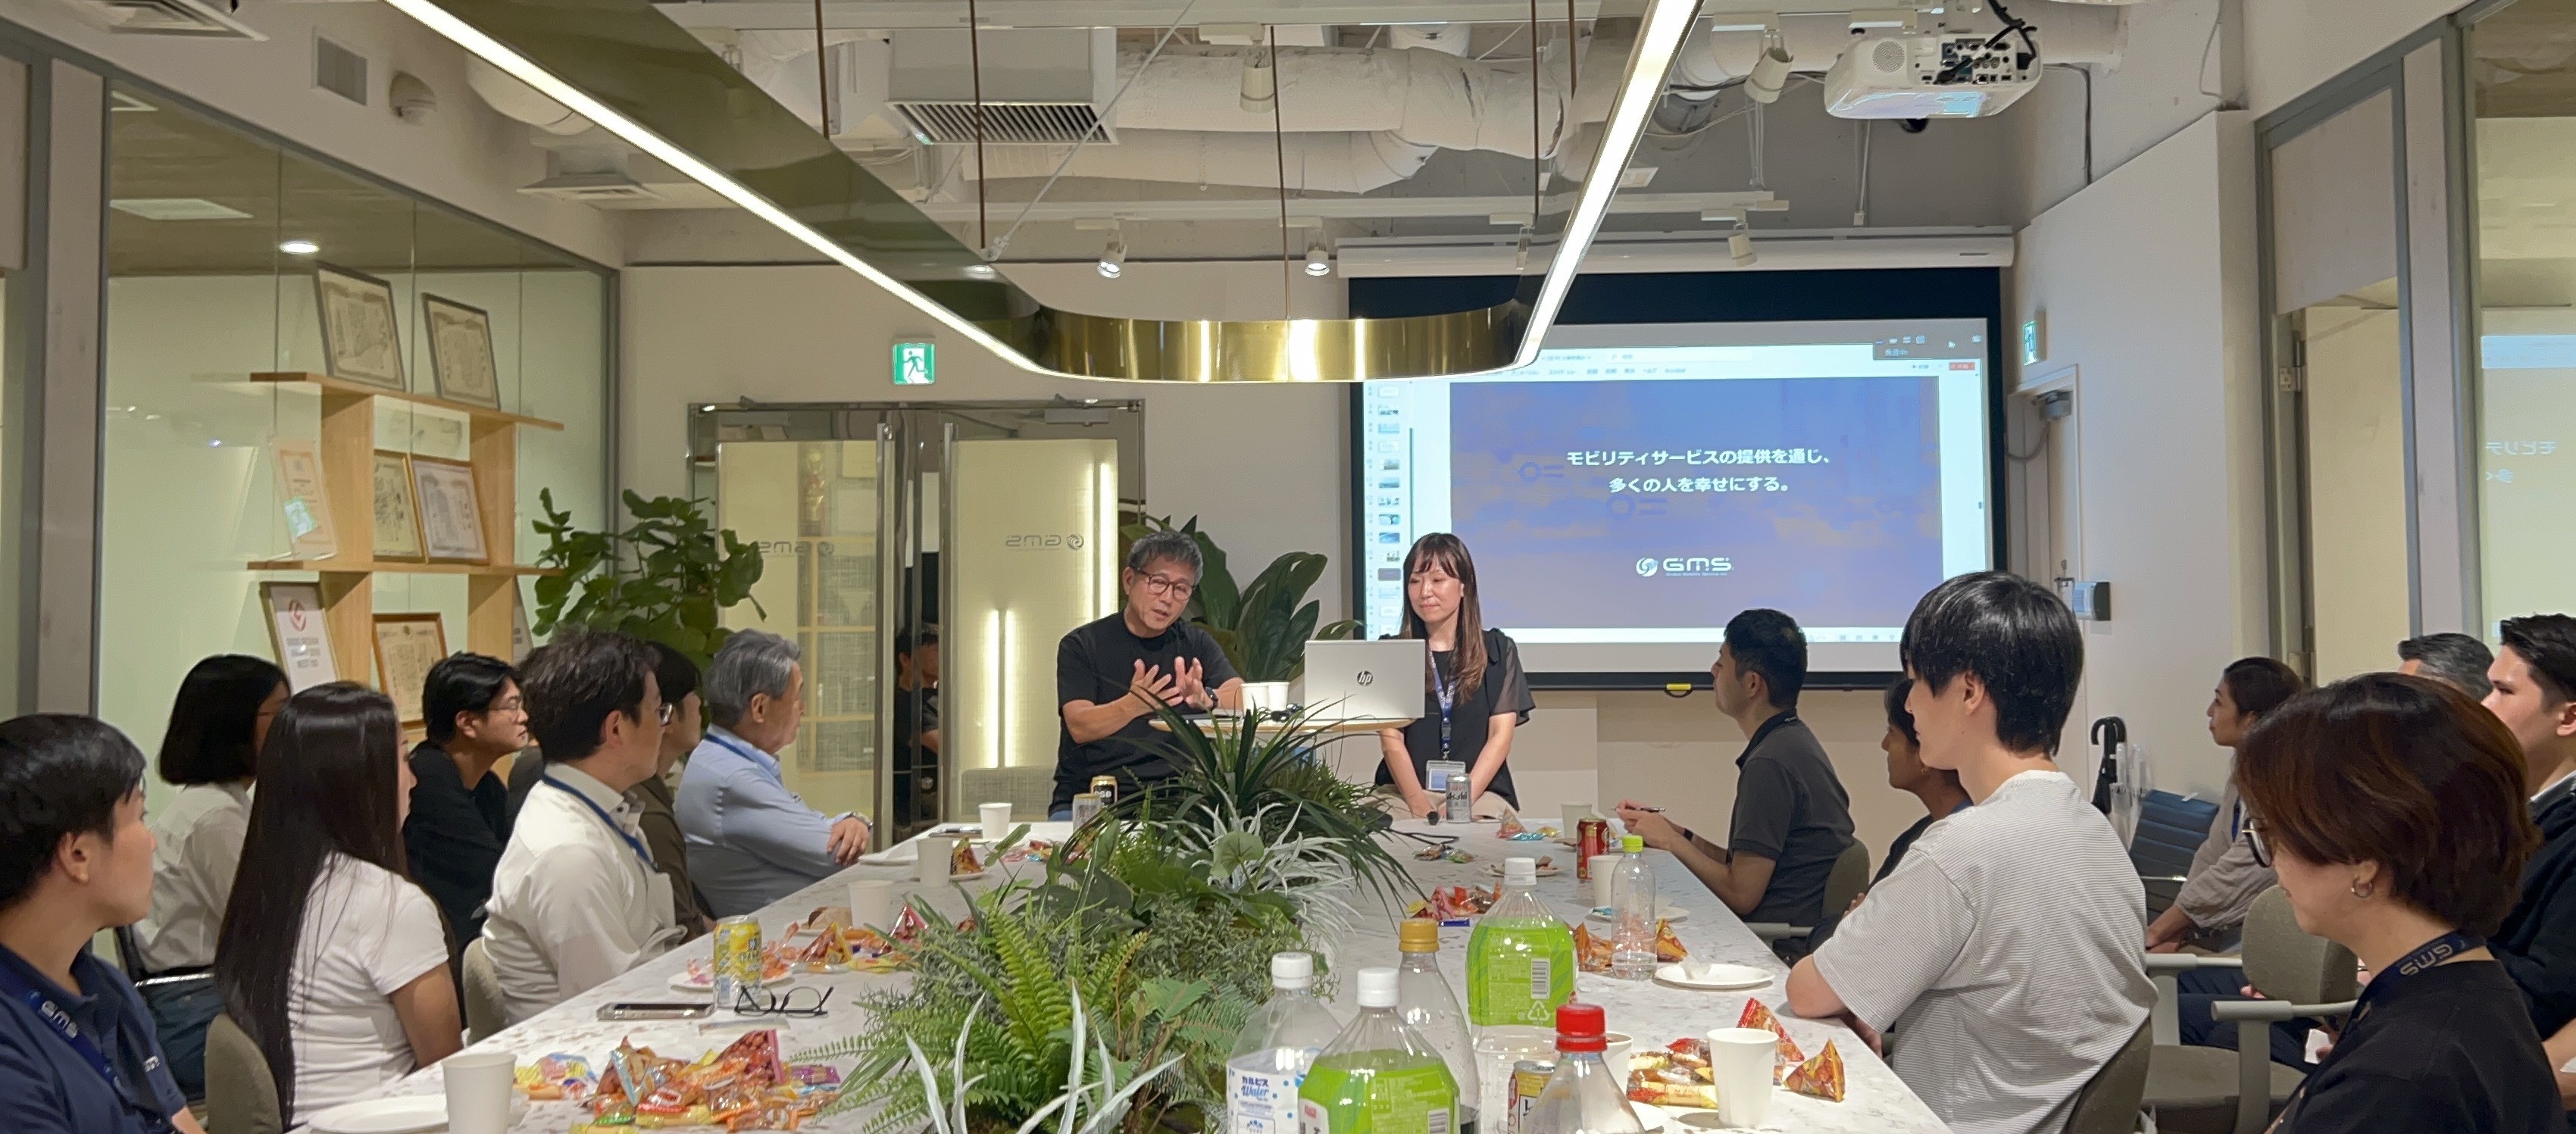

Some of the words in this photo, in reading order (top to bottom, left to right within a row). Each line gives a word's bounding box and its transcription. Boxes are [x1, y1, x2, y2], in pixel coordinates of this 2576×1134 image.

[1567, 448, 1830, 466] モビリティサービスの提供を通じ、
[1609, 476, 1788, 493] 多くの人を幸せにする。
[1663, 558, 1732, 571] GMS
[1358, 670, 1372, 686] hp
[1447, 792, 1468, 800] Asahi
[2399, 944, 2453, 975] GMS
